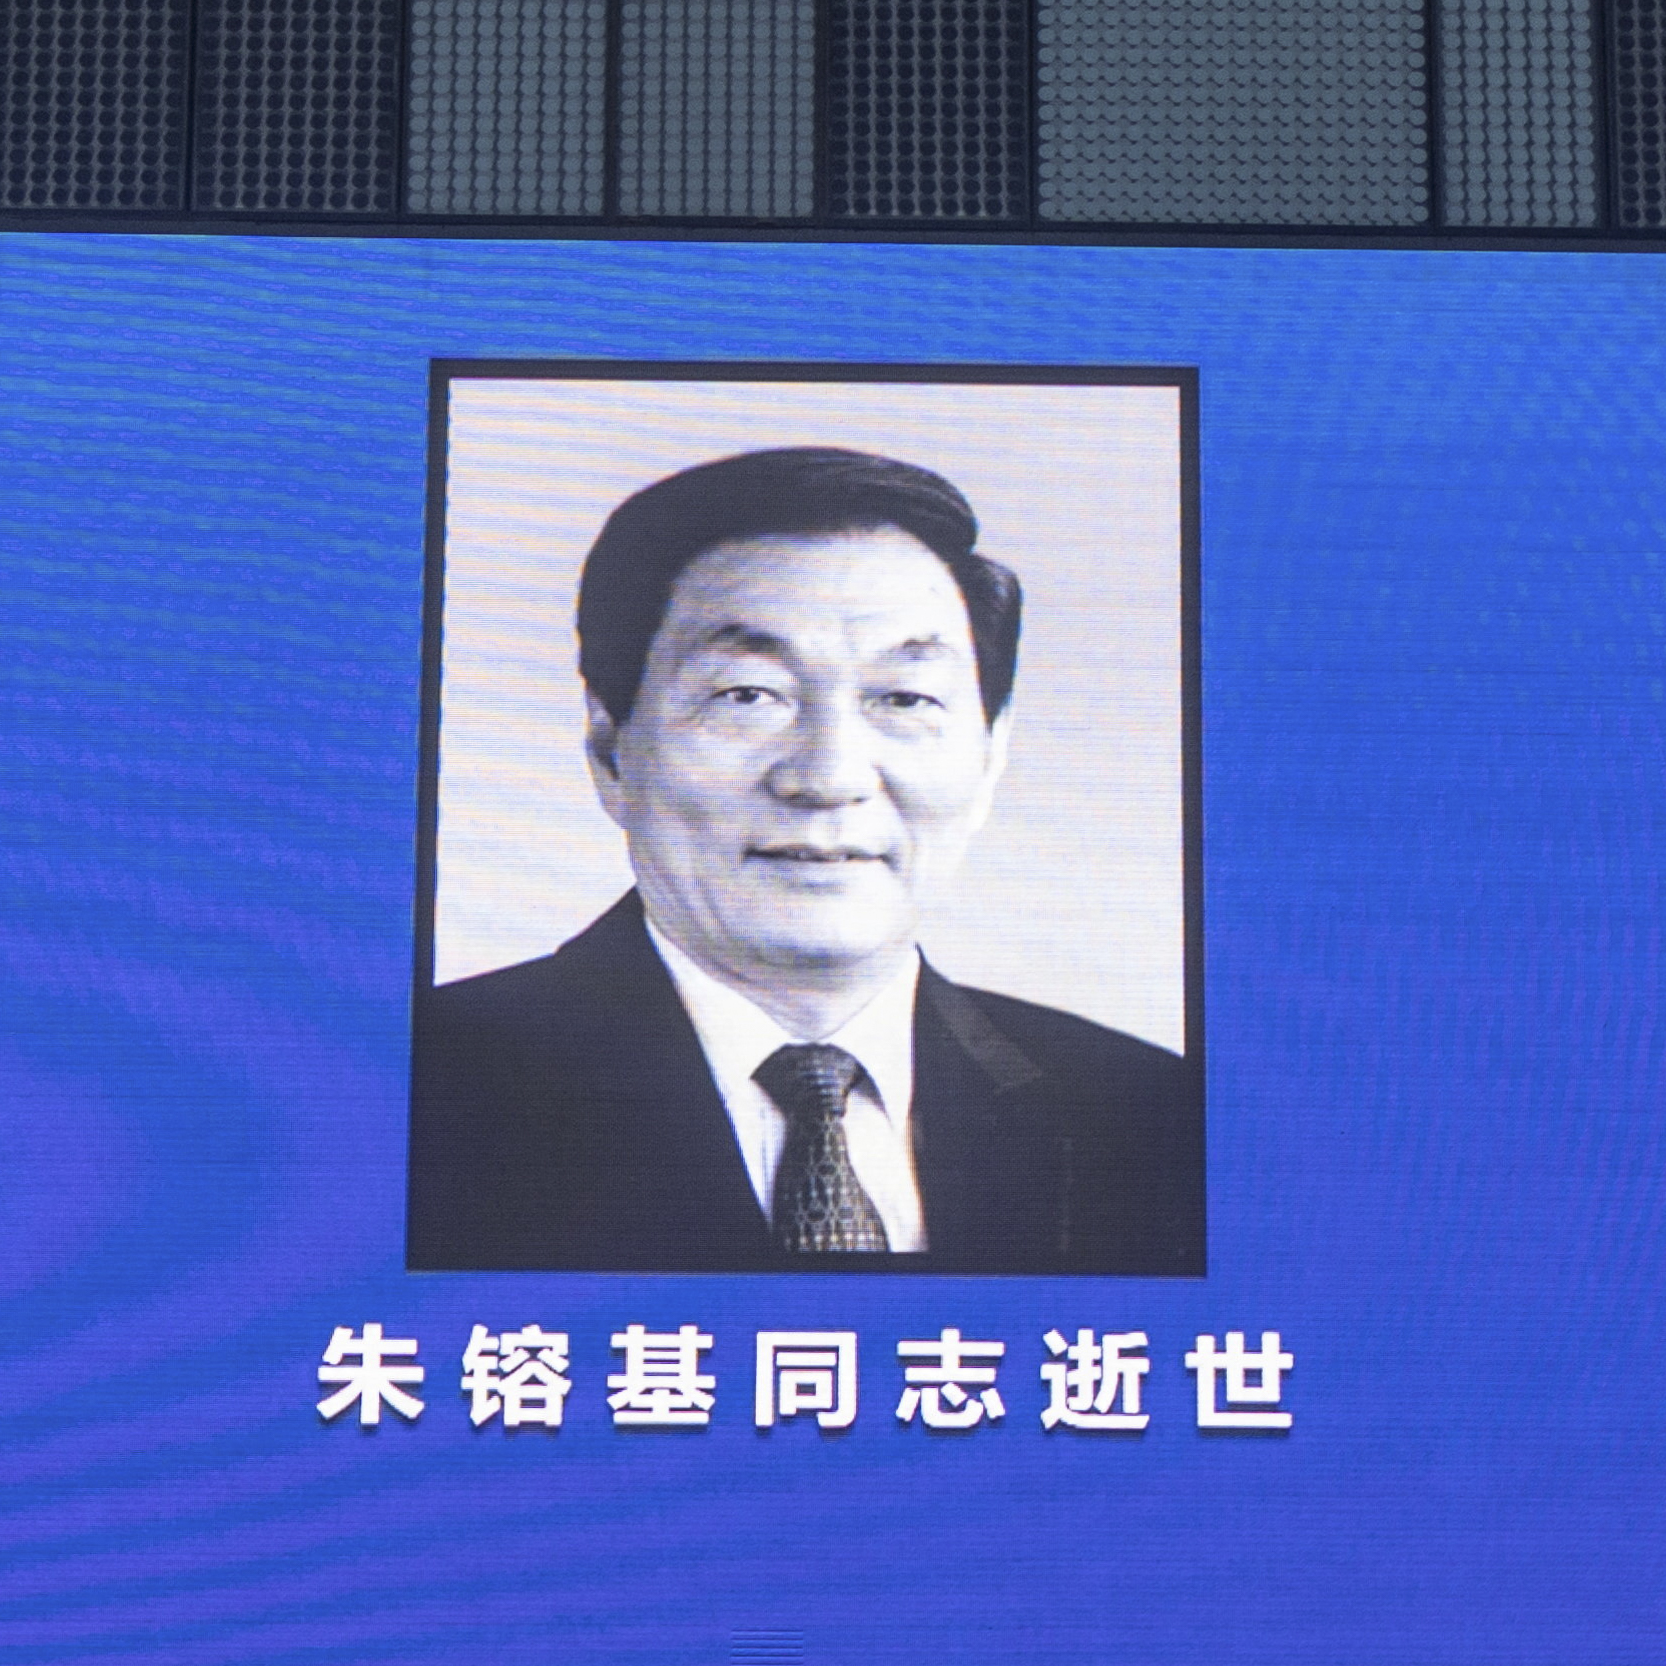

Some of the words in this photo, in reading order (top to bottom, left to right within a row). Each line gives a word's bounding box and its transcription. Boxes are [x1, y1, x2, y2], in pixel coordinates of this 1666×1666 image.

[316, 1322, 1295, 1432] 朱镕基同志逝世
